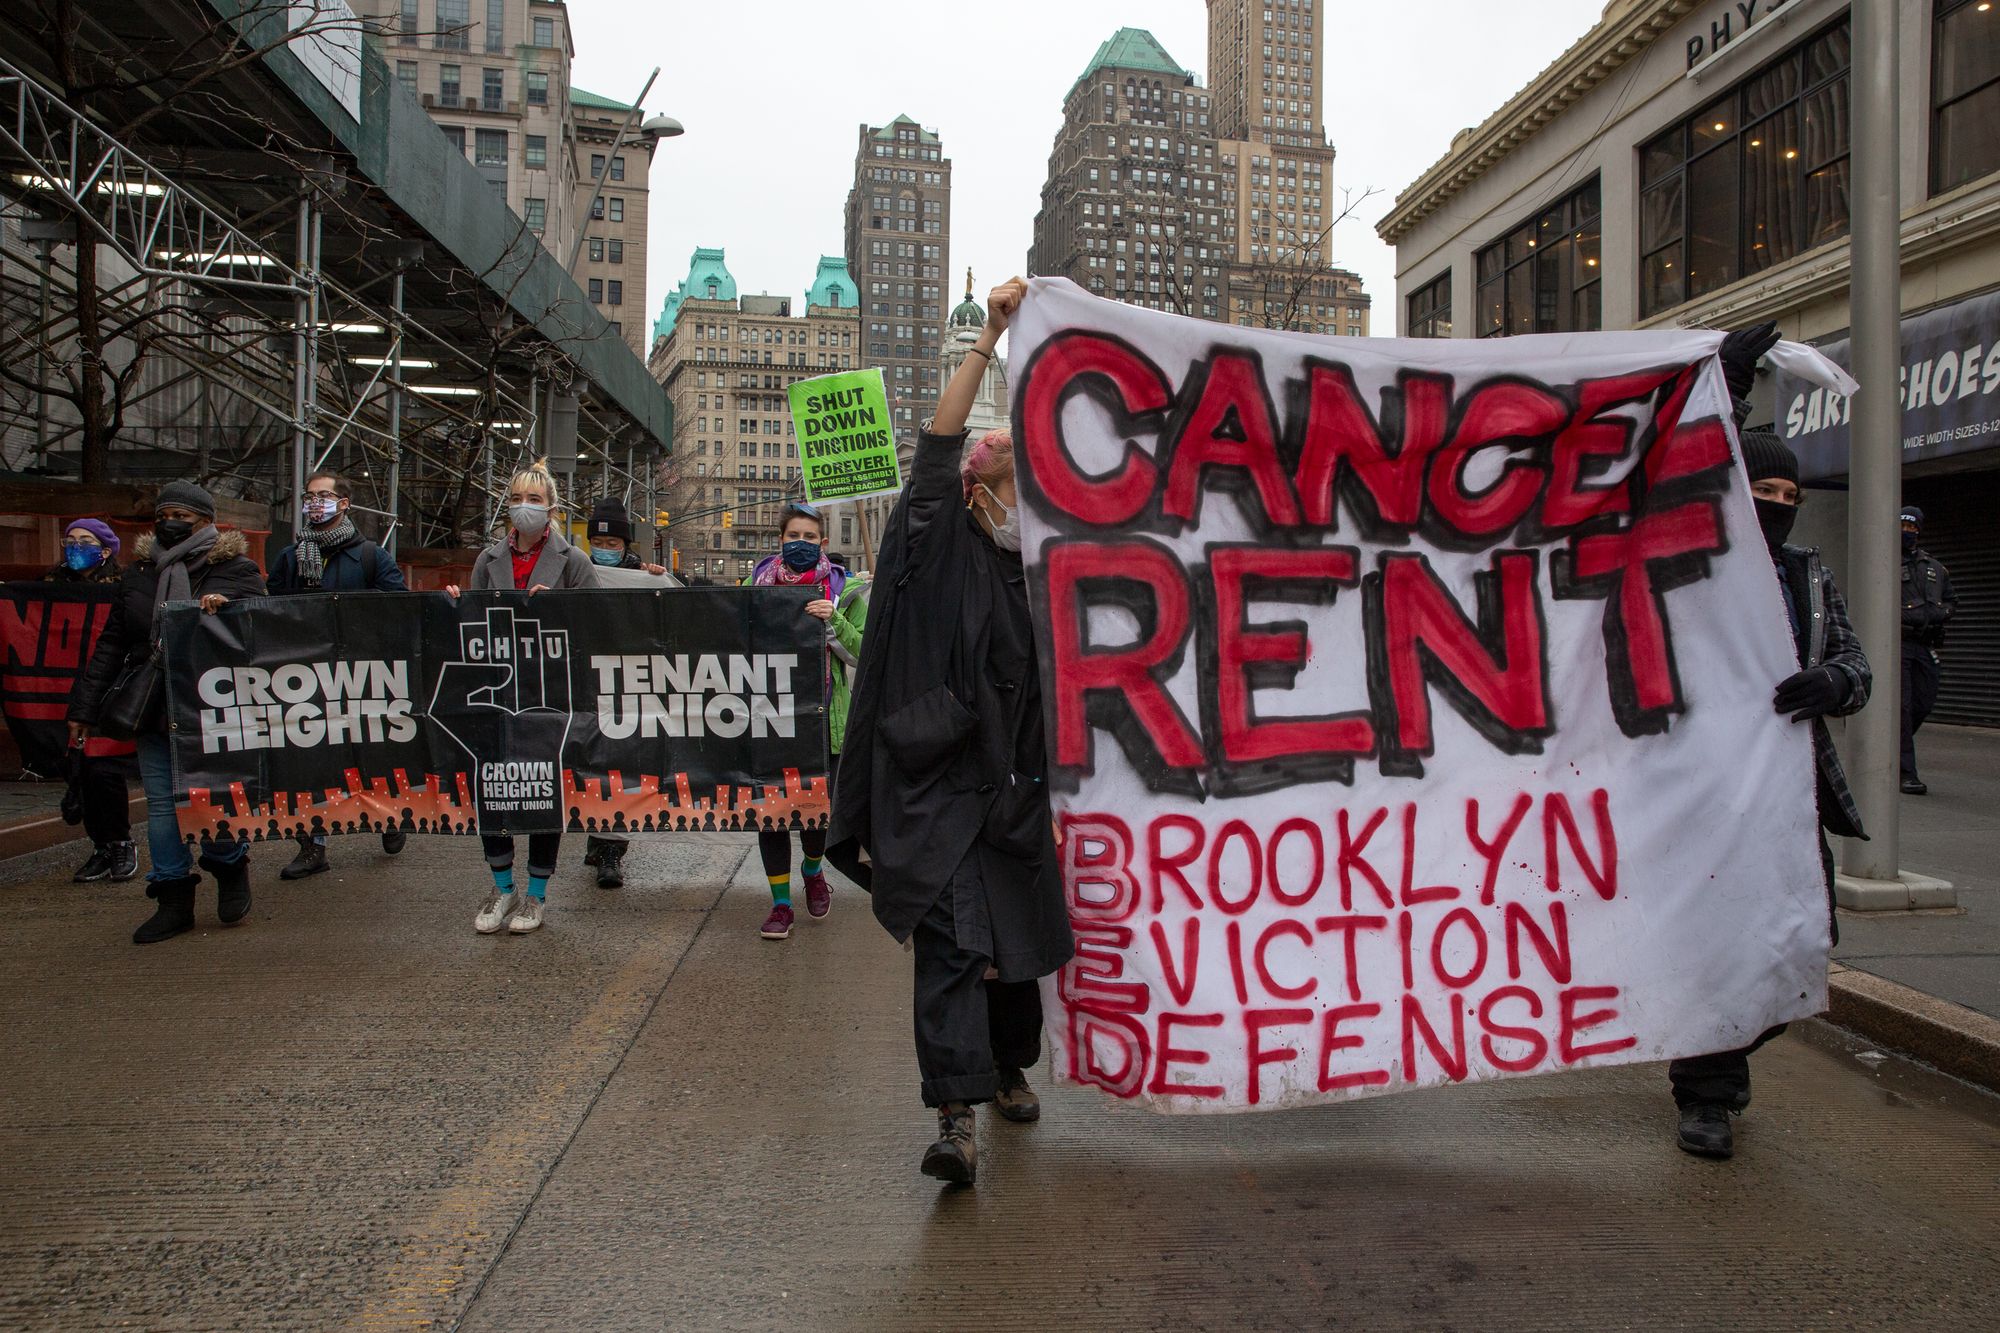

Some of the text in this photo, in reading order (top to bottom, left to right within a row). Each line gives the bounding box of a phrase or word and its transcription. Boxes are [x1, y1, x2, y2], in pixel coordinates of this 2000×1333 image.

[1687, 0, 1786, 71] PHY
[1901, 340, 2000, 411] HOES
[806, 387, 864, 414] SHUT
[804, 407, 876, 436] DOWN
[1903, 434, 1925, 449] WIDE
[1926, 429, 1954, 445] WIDTH
[1954, 423, 1981, 440] SIZES
[805, 429, 889, 459] EVICTIONS
[811, 455, 890, 478] FOREVER!
[811, 469, 895, 489] WORKERS ASSEMBLY
[821, 480, 888, 497] AGAINST RACISM
[1033, 495, 1729, 803] RENT
[198, 660, 409, 708] CROWN
[591, 653, 799, 694] TENANT
[200, 699, 418, 754] HEIGHTS
[597, 694, 796, 740] UNION
[481, 761, 554, 782] CROWN
[483, 779, 554, 799] HEIGHTS
[484, 799, 554, 812] TENANT UNION
[1058, 789, 1618, 922] BROOKLYN
[1057, 901, 1572, 1015] EVICTION
[1068, 986, 1638, 1104] DEFENSE
